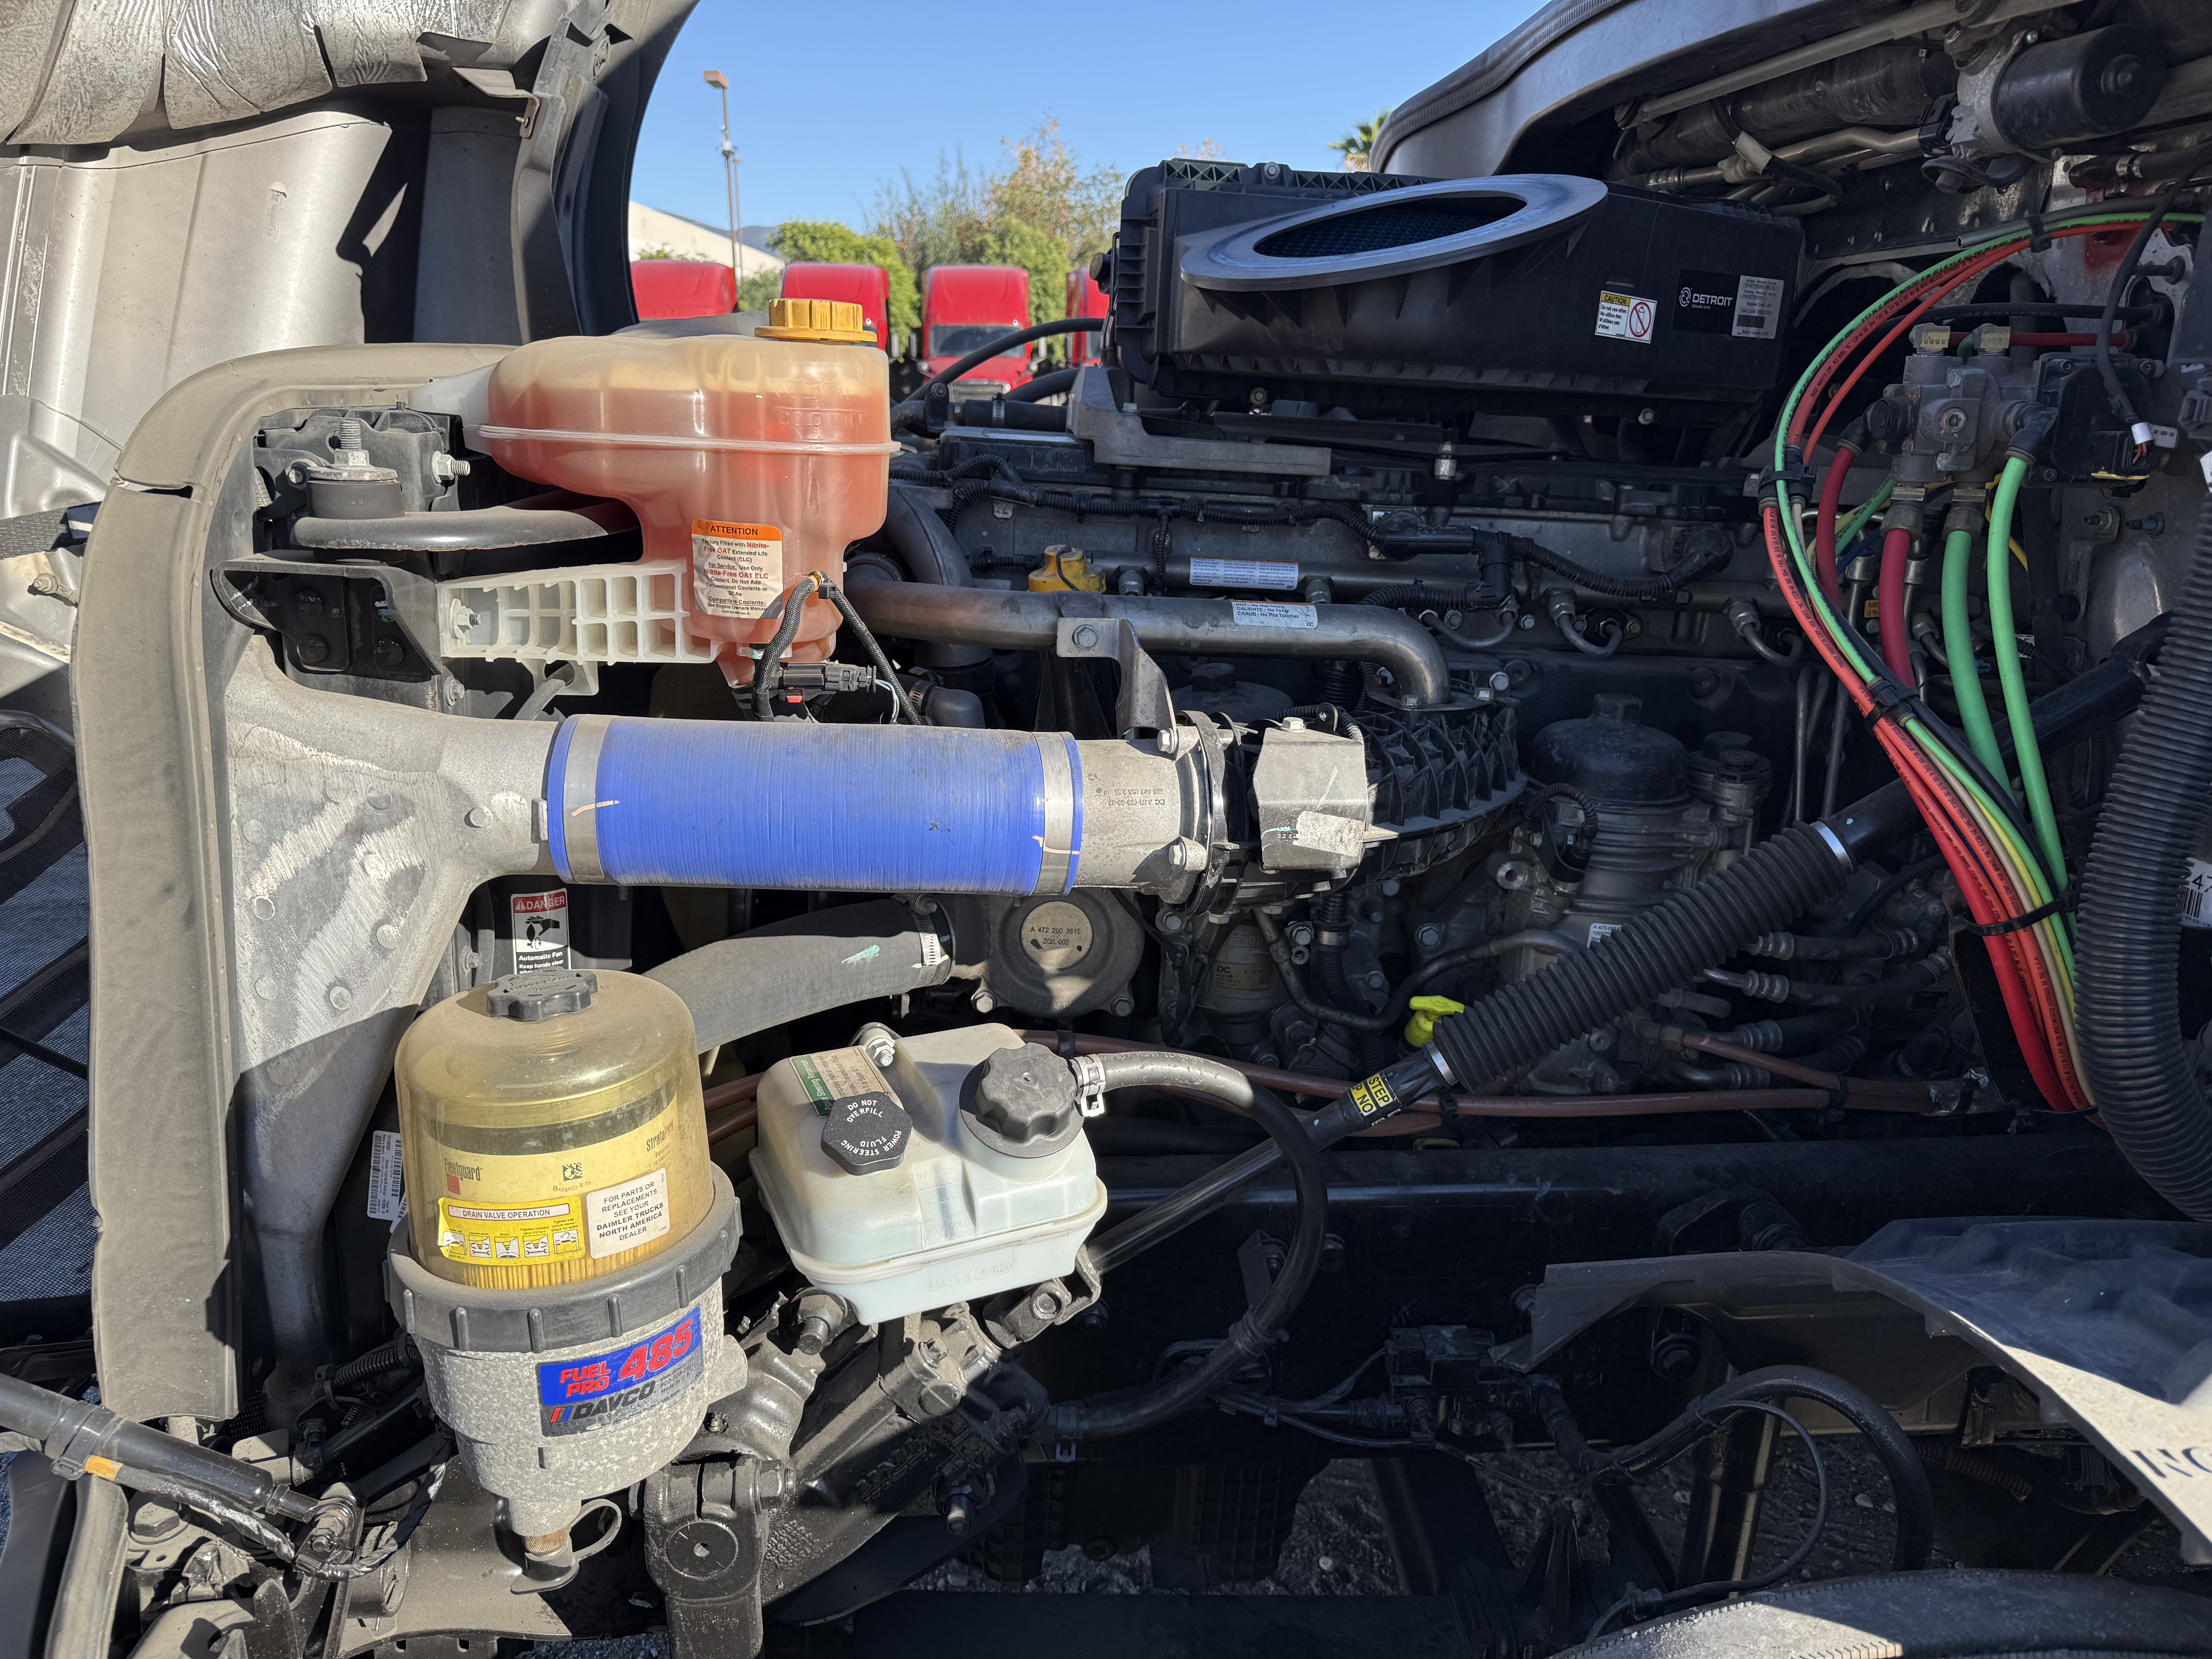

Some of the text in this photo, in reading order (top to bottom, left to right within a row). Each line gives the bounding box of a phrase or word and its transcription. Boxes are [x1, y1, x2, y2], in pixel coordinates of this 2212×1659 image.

[1604, 295, 1626, 304] CAUTION
[1692, 294, 1733, 306] DETROIT
[776, 385, 820, 399] COLD
[778, 412, 822, 426] COLD
[711, 526, 758, 536] ATTENTION
[704, 569, 737, 577] Nitrite-Free
[527, 896, 565, 910] DANGER
[801, 1060, 816, 1079] Reservoir
[837, 1063, 852, 1084] Transmission
[812, 1078, 826, 1097] Steering
[1369, 1077, 1390, 1103] STEP
[847, 1102, 858, 1111] DO
[1357, 1094, 1373, 1113] NO
[847, 1107, 884, 1122] OVERFILL
[841, 1130, 902, 1156] POWER STEERING
[860, 1136, 887, 1147] FLUID
[602, 1188, 657, 1212] REPLACEMENTS
[605, 1195, 620, 1204] FOR
[622, 1186, 643, 1199] PARTS
[508, 1209, 550, 1218] OPERATION
[597, 1202, 663, 1230] DAIMLER TRUCKS
[614, 1201, 649, 1217] SEE YOUR
[599, 1225, 628, 1238] NORTH
[630, 1211, 662, 1229] AMERICA
[620, 1226, 647, 1240] DEALER
[560, 1317, 693, 1384] FUEL 485
[566, 1376, 610, 1397] PRO
[661, 1384, 674, 1394] Made
[572, 1380, 656, 1420] DAVCO
